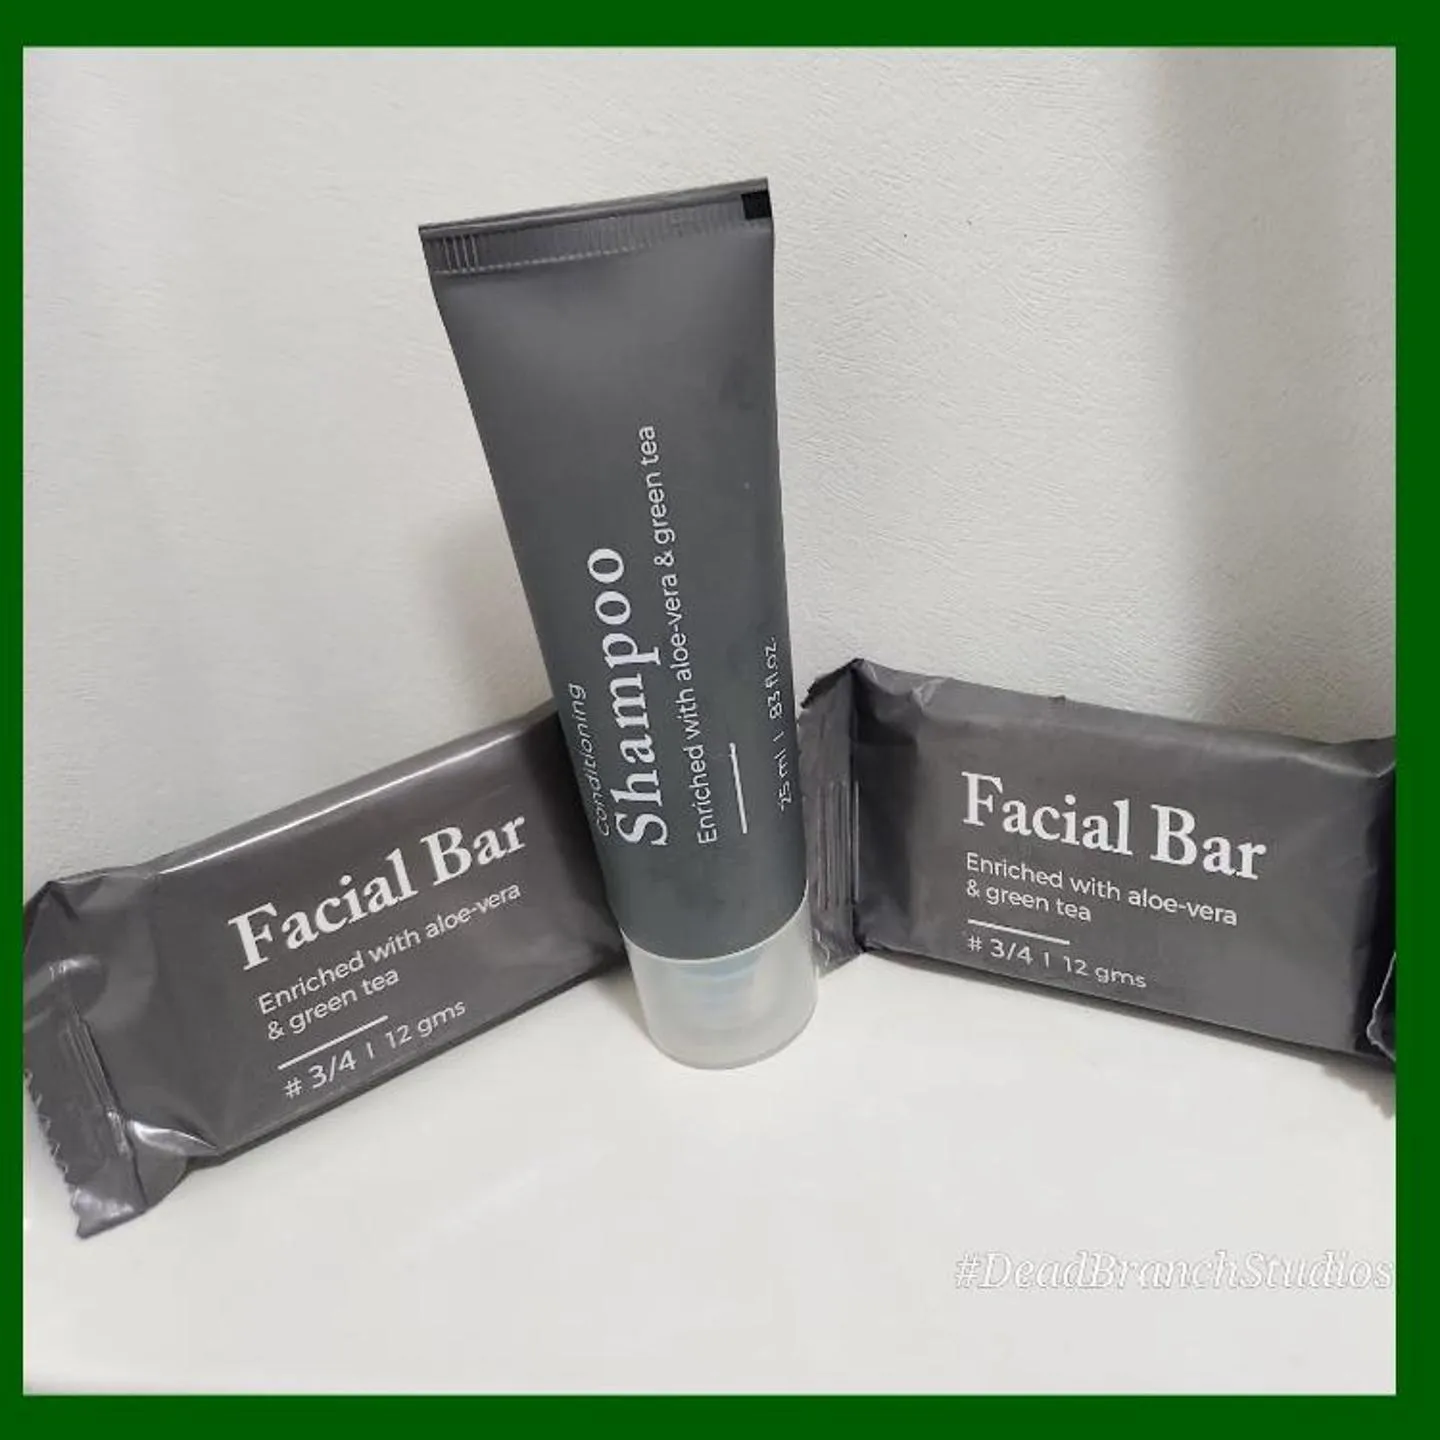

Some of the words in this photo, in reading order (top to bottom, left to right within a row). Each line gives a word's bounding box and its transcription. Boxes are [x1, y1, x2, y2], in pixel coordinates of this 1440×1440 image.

[638, 424, 660, 466] tea
[645, 470, 676, 545] green
[653, 549, 676, 567] &
[659, 571, 696, 684] aloe-vera
[587, 547, 668, 848] Shampoo
[676, 688, 704, 739] with
[684, 745, 718, 846] Enriched
[961, 770, 1133, 856] Facial
[1149, 803, 1267, 881] Bar
[227, 848, 419, 971] Facial
[420, 814, 527, 886] Bar
[965, 851, 1063, 890] Enriched
[1069, 874, 1121, 902] with
[1127, 888, 1239, 926] aloe-vera
[965, 877, 981, 898] &
[985, 882, 1049, 914] green
[1055, 894, 1092, 922] tea
[258, 950, 365, 1015] Enriched
[367, 928, 423, 963] with
[424, 883, 522, 940] aloe-vera
[966, 934, 983, 953] #
[990, 938, 1034, 967] 3/4
[1063, 954, 1090, 977] 12
[1094, 967, 1148, 989] gms
[266, 1019, 286, 1042] &
[287, 987, 359, 1035] green
[362, 967, 401, 997] tea
[283, 1076, 303, 1100] #
[308, 1049, 358, 1090] 3/4
[384, 1023, 412, 1050] 12
[415, 999, 466, 1038] gms
